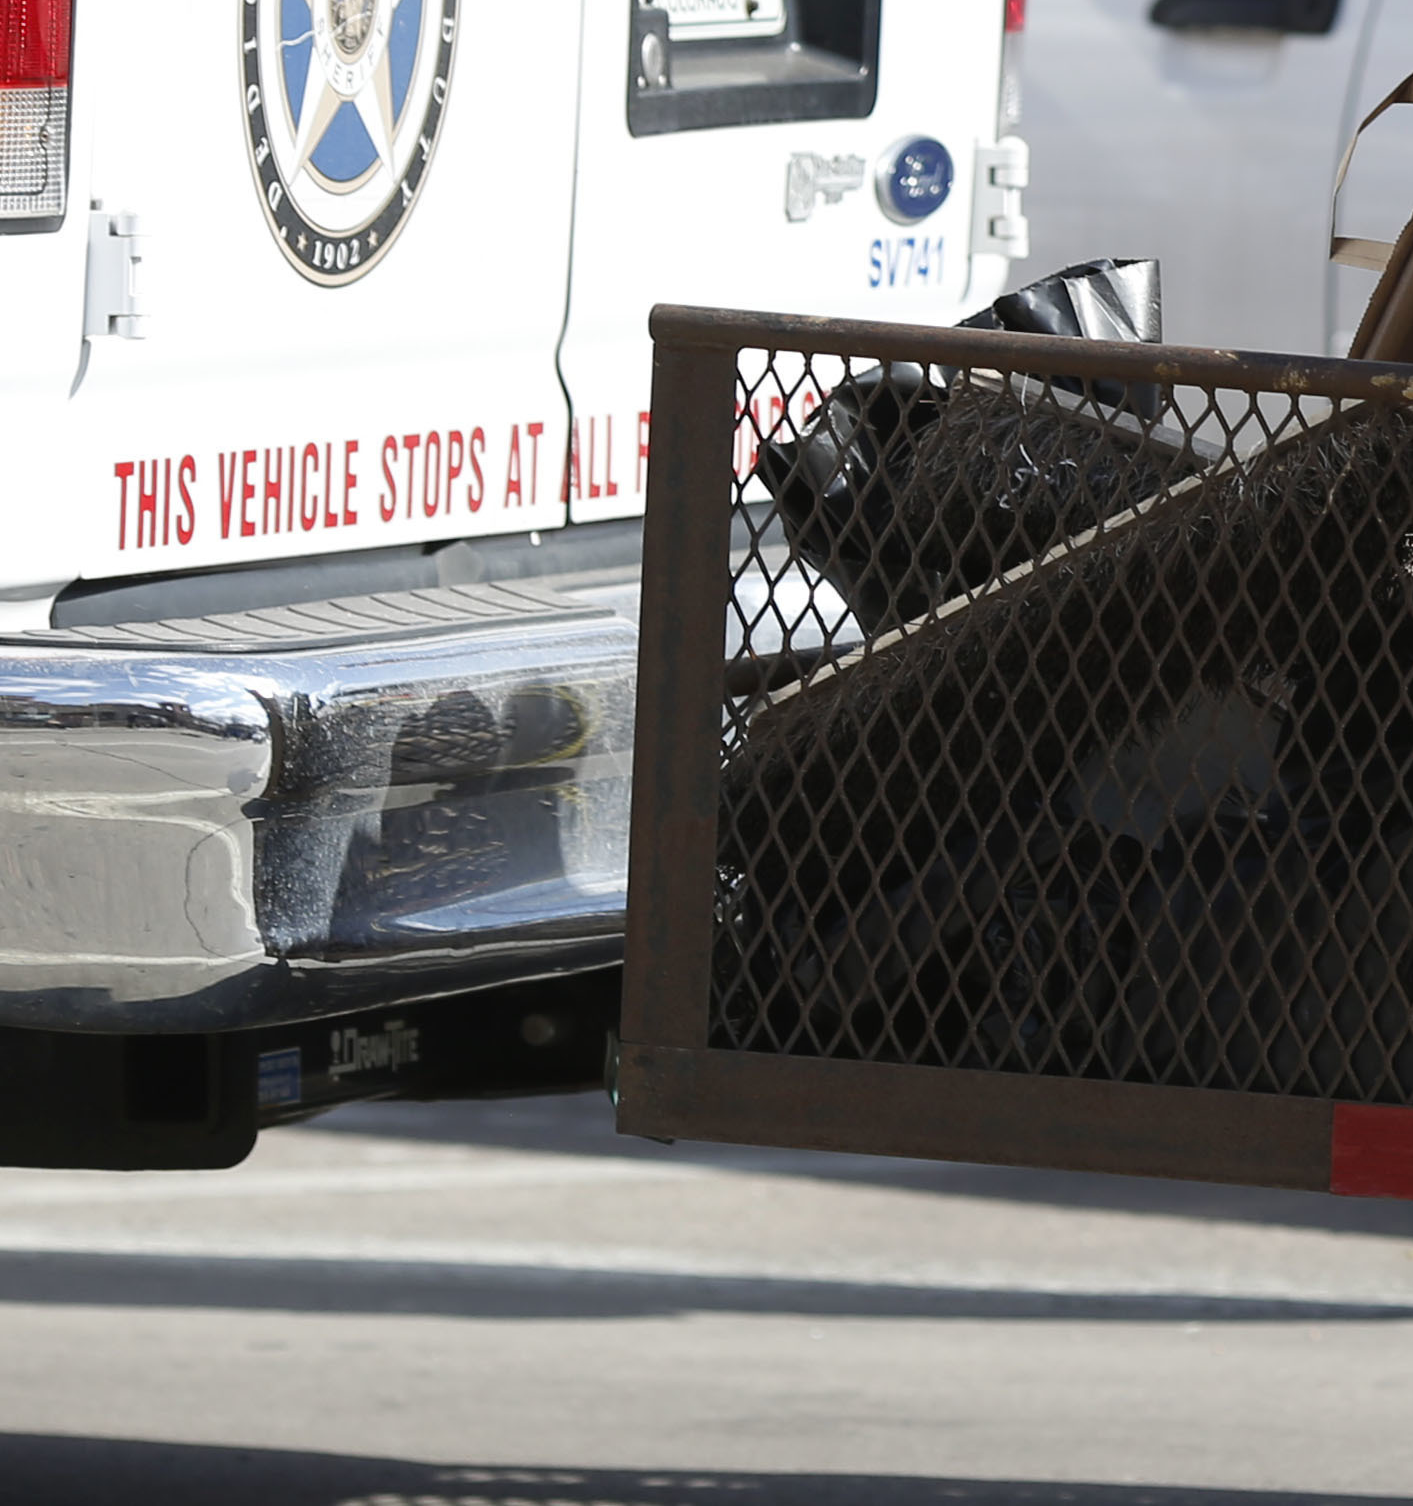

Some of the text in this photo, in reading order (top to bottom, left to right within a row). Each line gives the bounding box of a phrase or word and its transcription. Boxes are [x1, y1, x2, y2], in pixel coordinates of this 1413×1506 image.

[400, 16, 456, 208] DUTY
[311, 238, 361, 271] 1902
[866, 234, 946, 290] SV741
[114, 453, 197, 551] THIS
[218, 439, 360, 540] VEHICLE
[379, 425, 486, 524] STOPS
[504, 421, 545, 508] AT
[560, 414, 619, 504] ALL
